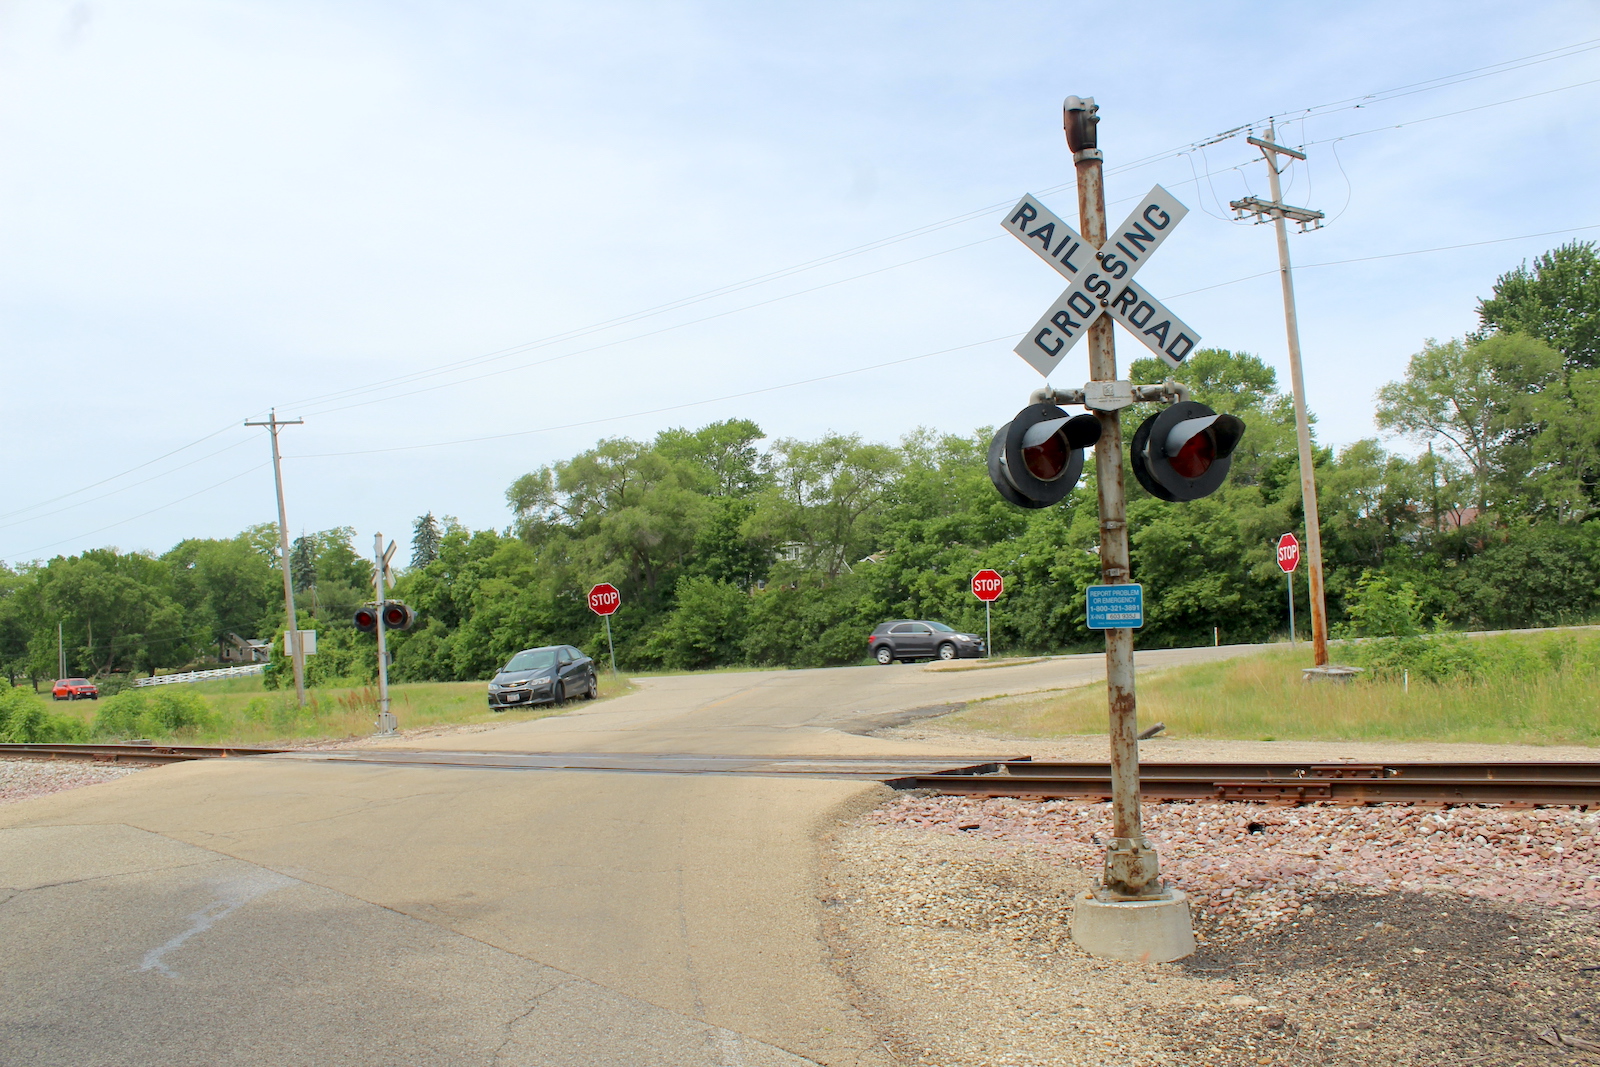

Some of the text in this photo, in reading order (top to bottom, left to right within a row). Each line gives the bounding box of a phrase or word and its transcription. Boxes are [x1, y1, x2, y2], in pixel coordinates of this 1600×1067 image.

[1010, 202, 1194, 362] RAIL ROAD
[1034, 204, 1171, 357] CROSSING
[1278, 544, 1297, 561] STOP
[974, 579, 1000, 591] STOP
[591, 592, 617, 606] STOP
[1090, 604, 1140, 612] 1-800-321-3891
